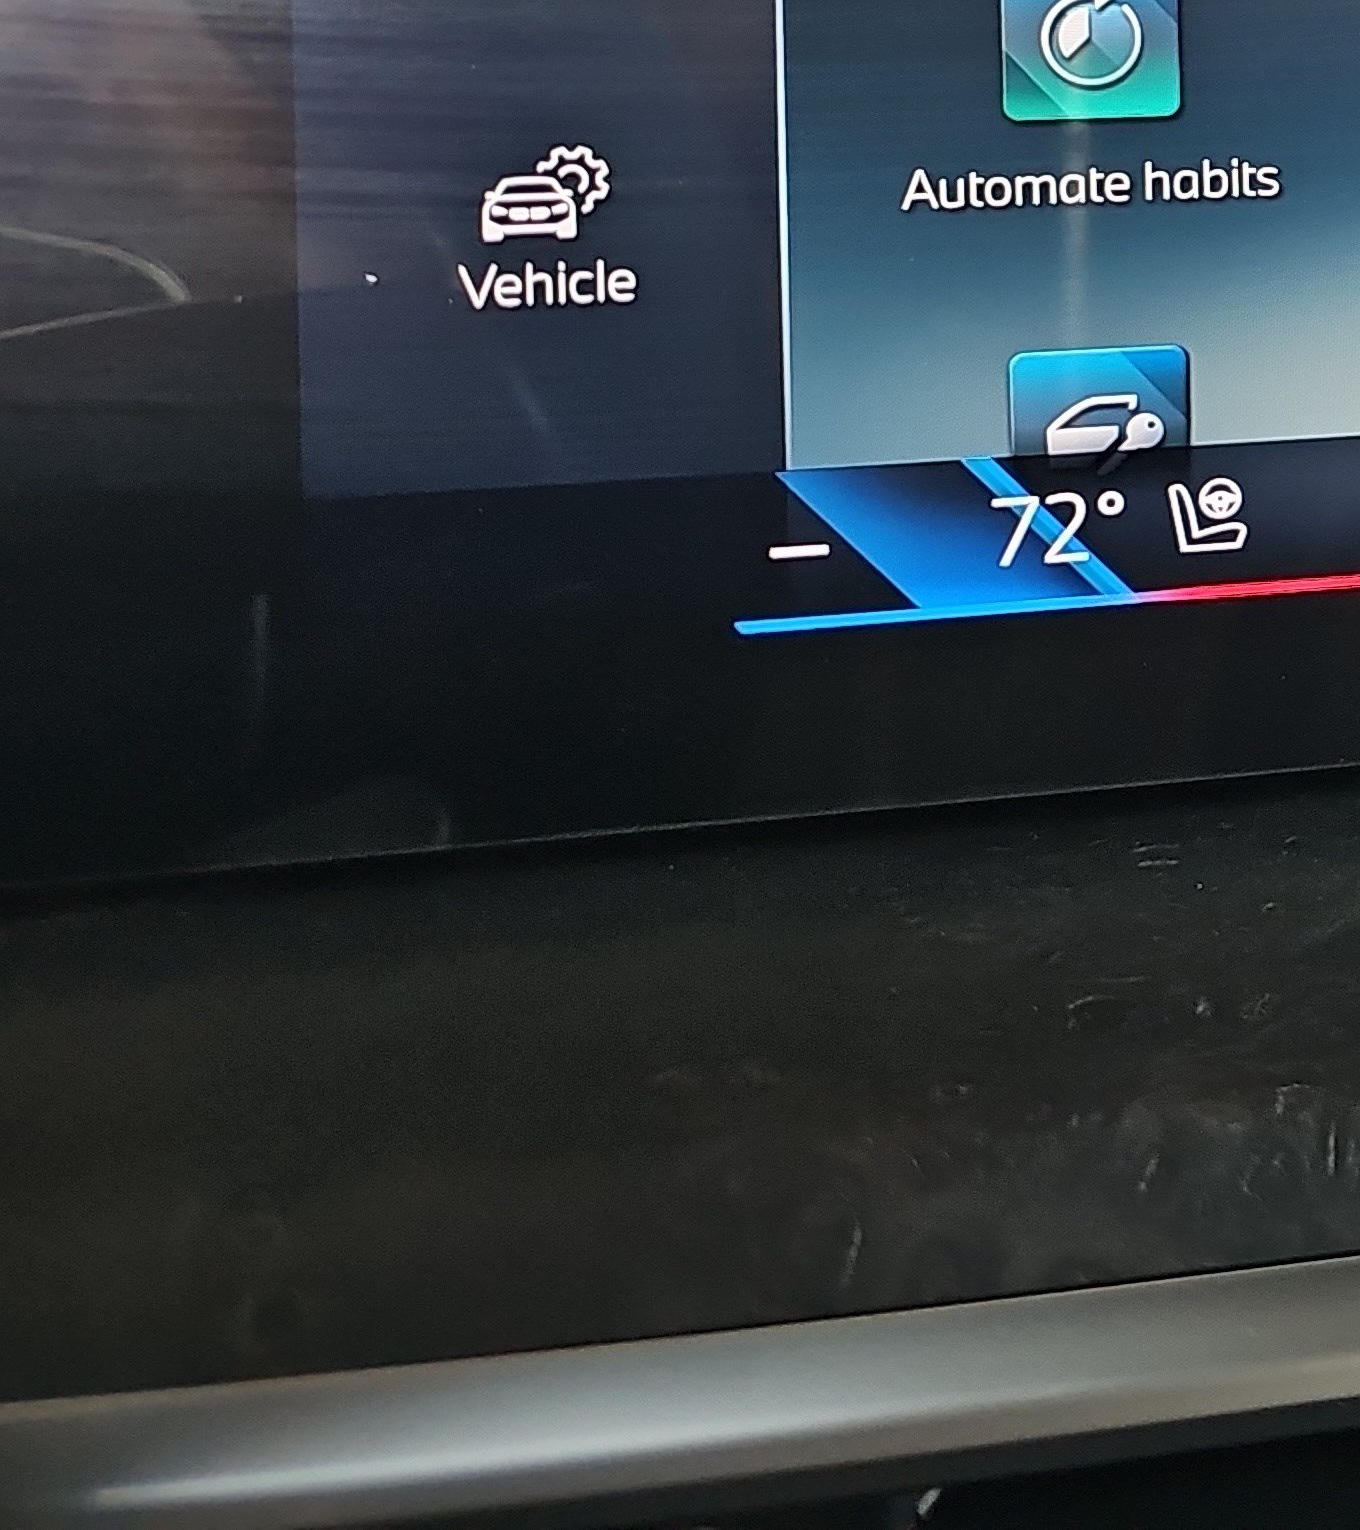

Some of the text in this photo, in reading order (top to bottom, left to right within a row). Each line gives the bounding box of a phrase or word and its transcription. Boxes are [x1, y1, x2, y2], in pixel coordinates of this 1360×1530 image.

[899, 157, 1281, 212] Automate habits
[458, 259, 638, 309] Vehicle
